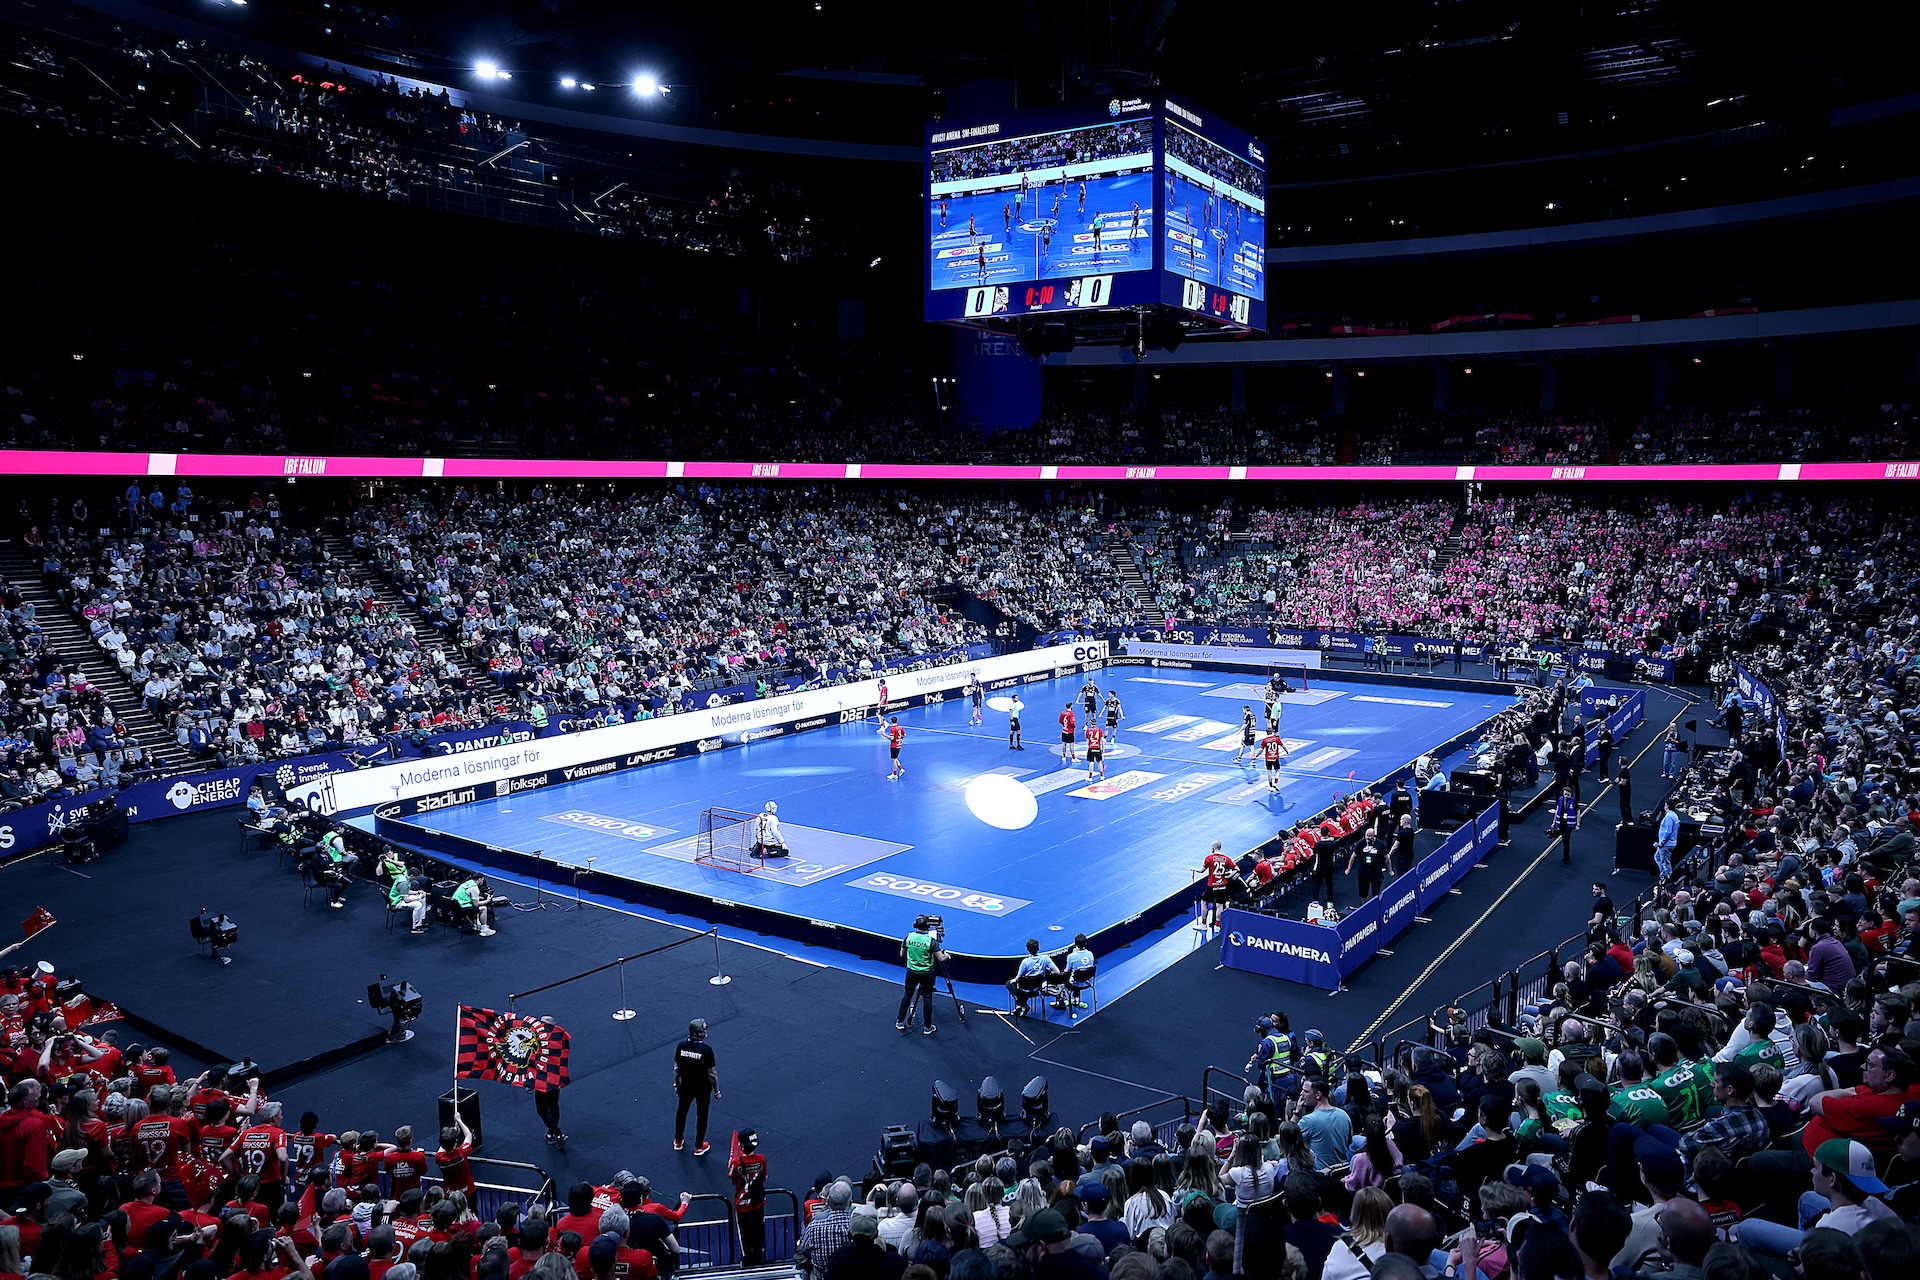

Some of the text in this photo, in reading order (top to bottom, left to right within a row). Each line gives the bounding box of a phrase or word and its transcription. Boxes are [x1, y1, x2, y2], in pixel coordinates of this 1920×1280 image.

[1122, 98, 1142, 107] Svensk
[1122, 102, 1151, 113] Innebandy
[946, 130, 961, 141] ARENA
[962, 126, 988, 138] SM-FINALEN
[1025, 285, 1055, 306] 0:00
[1091, 278, 1102, 303] 0
[975, 289, 985, 313] 0
[283, 458, 327, 474] IBF FALUN
[1551, 467, 1586, 479] IBF FALUN
[1884, 463, 1920, 478] IBF FALUN
[1279, 638, 1303, 646] ENERGY
[1281, 633, 1303, 641] CHEAP
[1073, 642, 1108, 661] ecit
[1138, 648, 1168, 657] Moderna
[1159, 659, 1192, 669] StarkRelation
[917, 674, 945, 687] Moderna
[990, 677, 1018, 690] UNIHOC
[711, 700, 804, 727] Moderna lösningar för
[839, 706, 870, 724] DBET
[1063, 715, 1068, 724] 6
[800, 718, 827, 730] PANTAMERA
[750, 727, 784, 740] StarkRelation
[1088, 730, 1100, 741] 24
[705, 742, 723, 752] ENERGY
[706, 738, 723, 747] CHEAP
[1266, 742, 1278, 752] 20
[626, 747, 677, 766] UNIHOC
[298, 761, 329, 774] Svensk
[400, 749, 541, 787] Moderna lösningar för
[573, 761, 617, 778] VÄSTANHEDE
[197, 777, 241, 795] CHEAP
[510, 773, 548, 792] folkspel
[192, 787, 241, 805] ENERGY
[416, 787, 476, 813] stadium
[558, 812, 628, 830] OBOS
[1481, 819, 1499, 839] PANTAMERA
[1452, 840, 1474, 865] PANTAMERA
[1213, 861, 1226, 876] 25
[1425, 862, 1450, 888] PANTAMERA
[867, 876, 962, 900] OBOS
[1388, 890, 1416, 919] PANTAMERA
[1344, 920, 1378, 953] PANTAMERA
[908, 940, 929, 949] MEDIA
[1246, 935, 1330, 965] PANTAMERA
[680, 1049, 703, 1060] SECURITY
[137, 1130, 171, 1140] ERIKSSON
[141, 1139, 167, 1164] 19
[242, 1141, 271, 1149] ERIKSSON
[244, 1149, 266, 1174] 19
